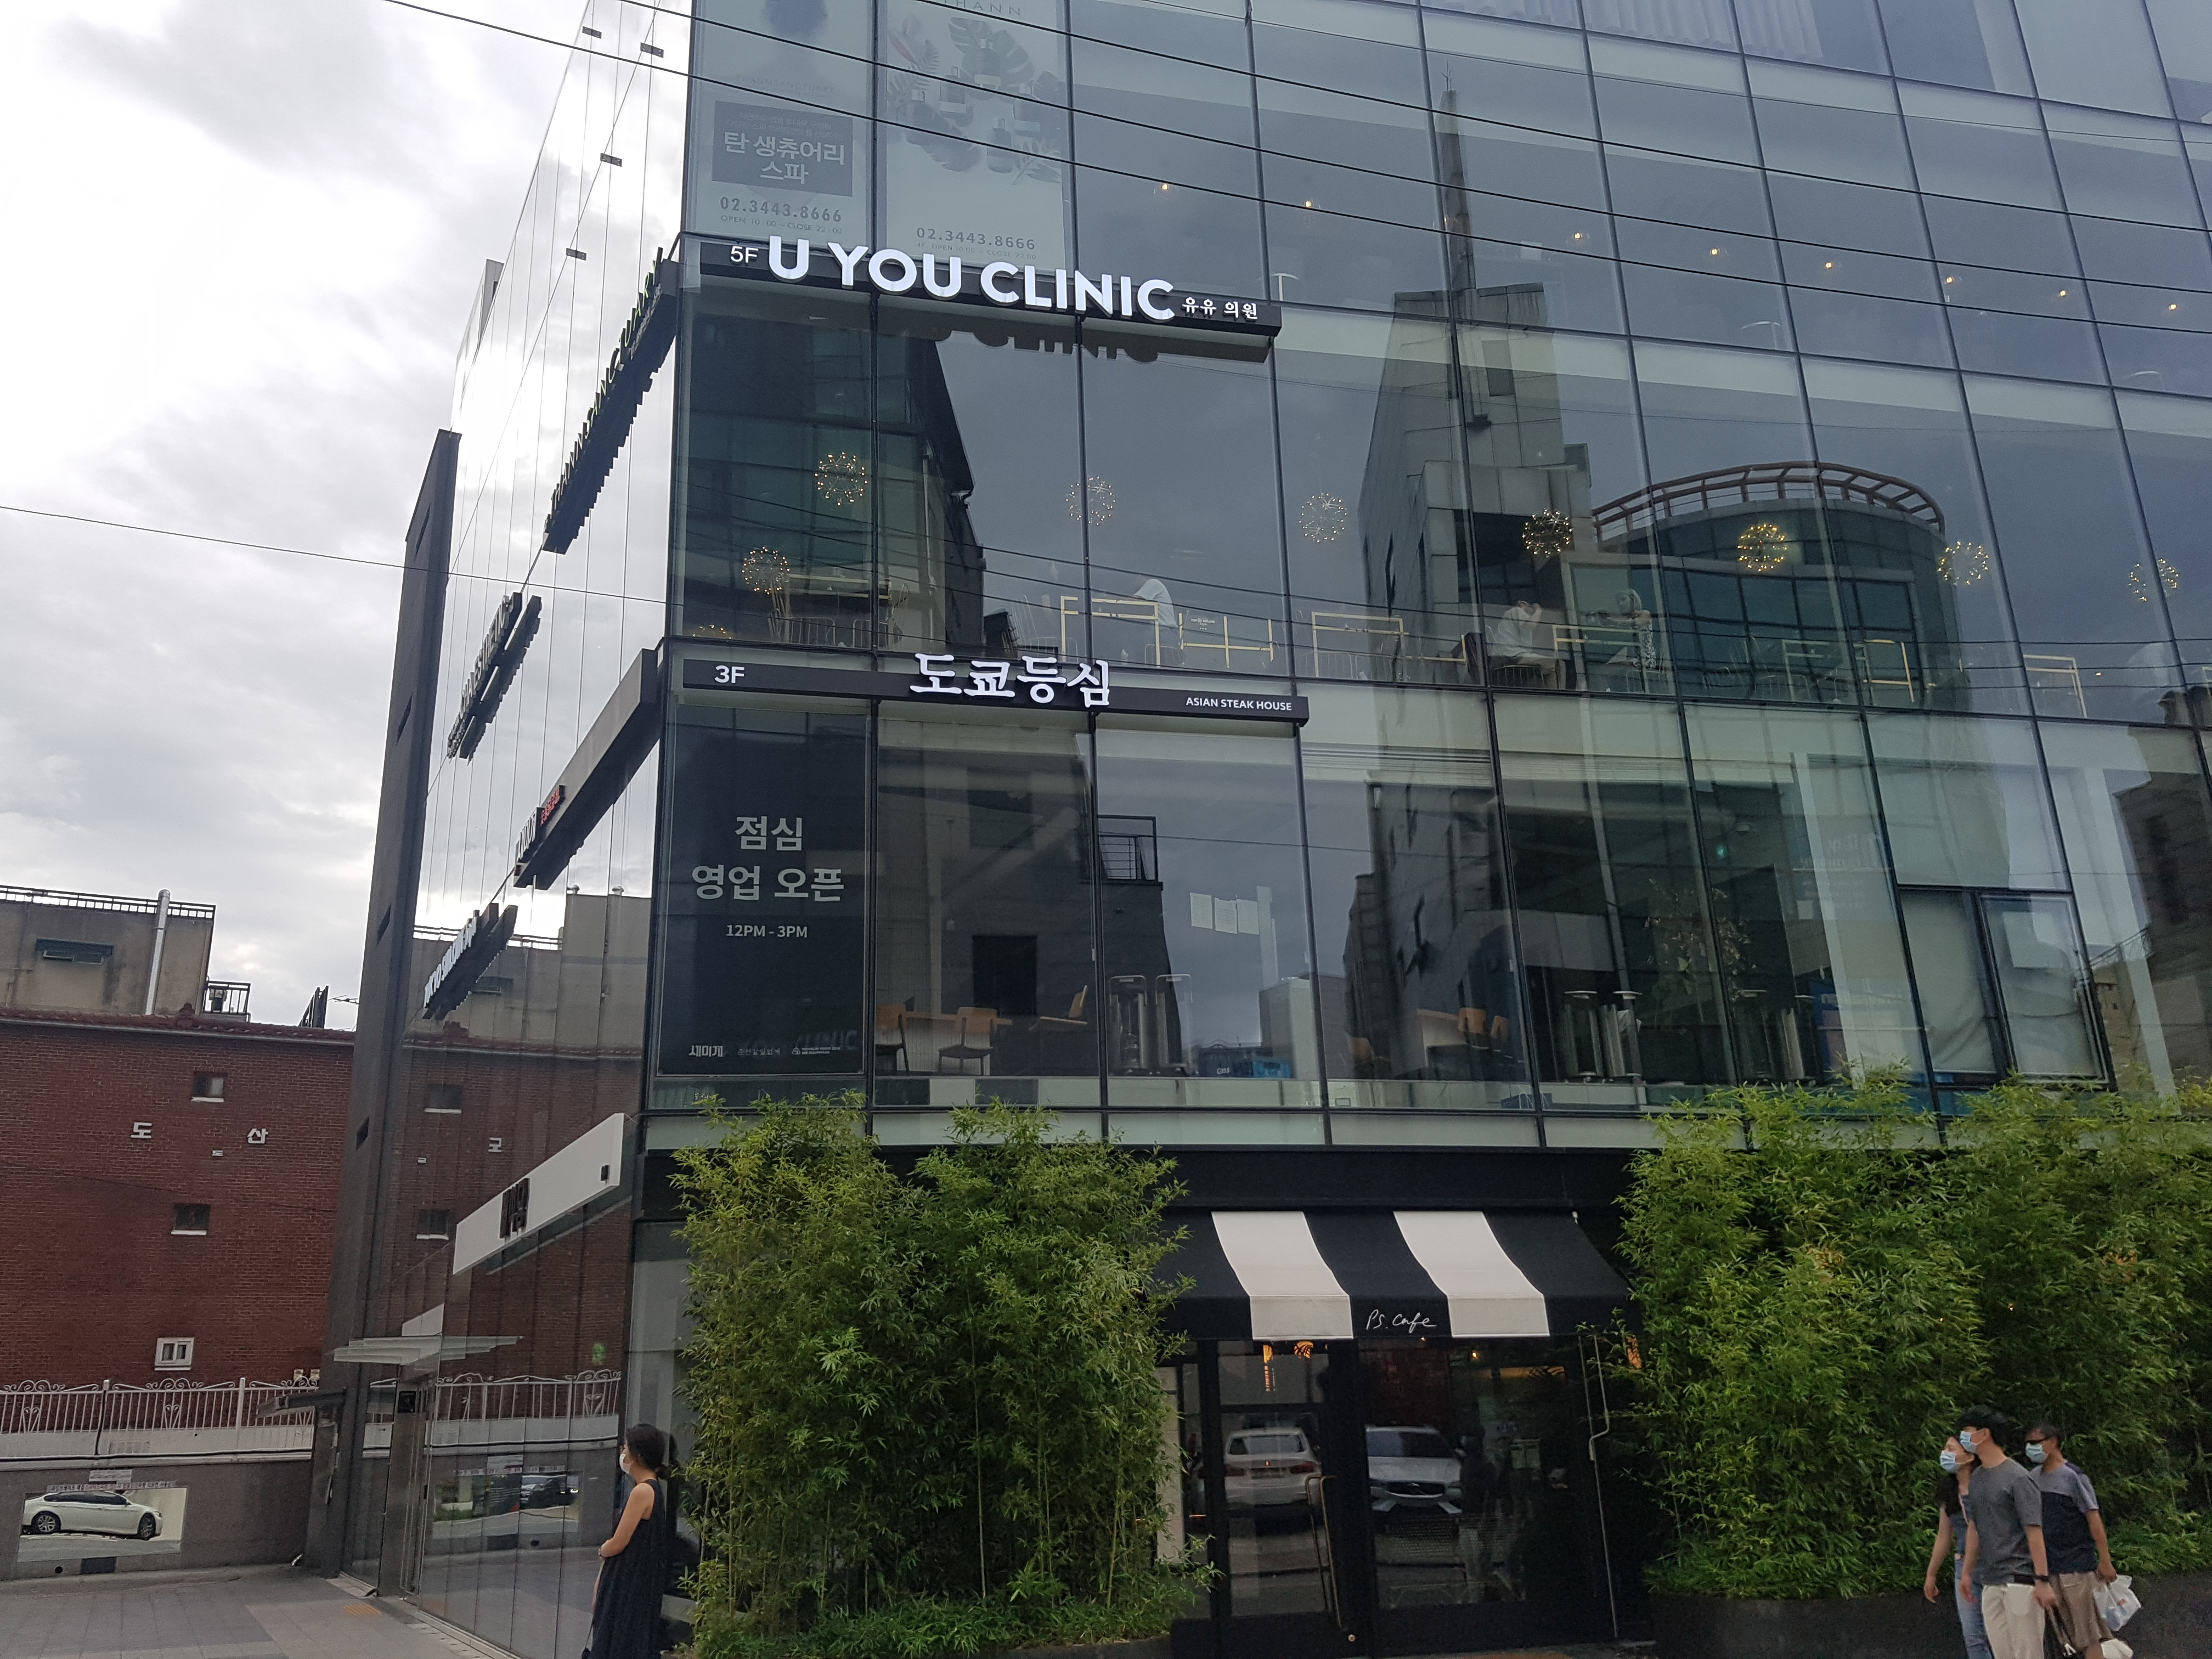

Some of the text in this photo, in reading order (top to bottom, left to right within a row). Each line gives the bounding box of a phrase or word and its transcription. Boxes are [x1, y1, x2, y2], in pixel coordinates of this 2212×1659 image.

[724, 131, 845, 165] 탄 생츄어리
[759, 161, 809, 184] 스파
[720, 196, 842, 222] 02.3443.8666
[720, 215, 746, 224] OPEN
[787, 222, 812, 231] CLOSE
[917, 227, 1035, 250] 02.3443.8666
[730, 246, 759, 263] 5F
[769, 235, 1175, 321] U YOU CLINIC
[1182, 296, 1259, 321] 유유 의원
[714, 664, 745, 684] 3F
[910, 653, 1111, 708] 도쿄등심
[1186, 697, 1293, 712] ASIAN STEAK HOUSE
[735, 816, 803, 851] 점심
[692, 864, 844, 902] 영업 오픈
[726, 924, 765, 938] 12PM
[777, 926, 808, 938] 3PM
[130, 1122, 152, 1139] 도
